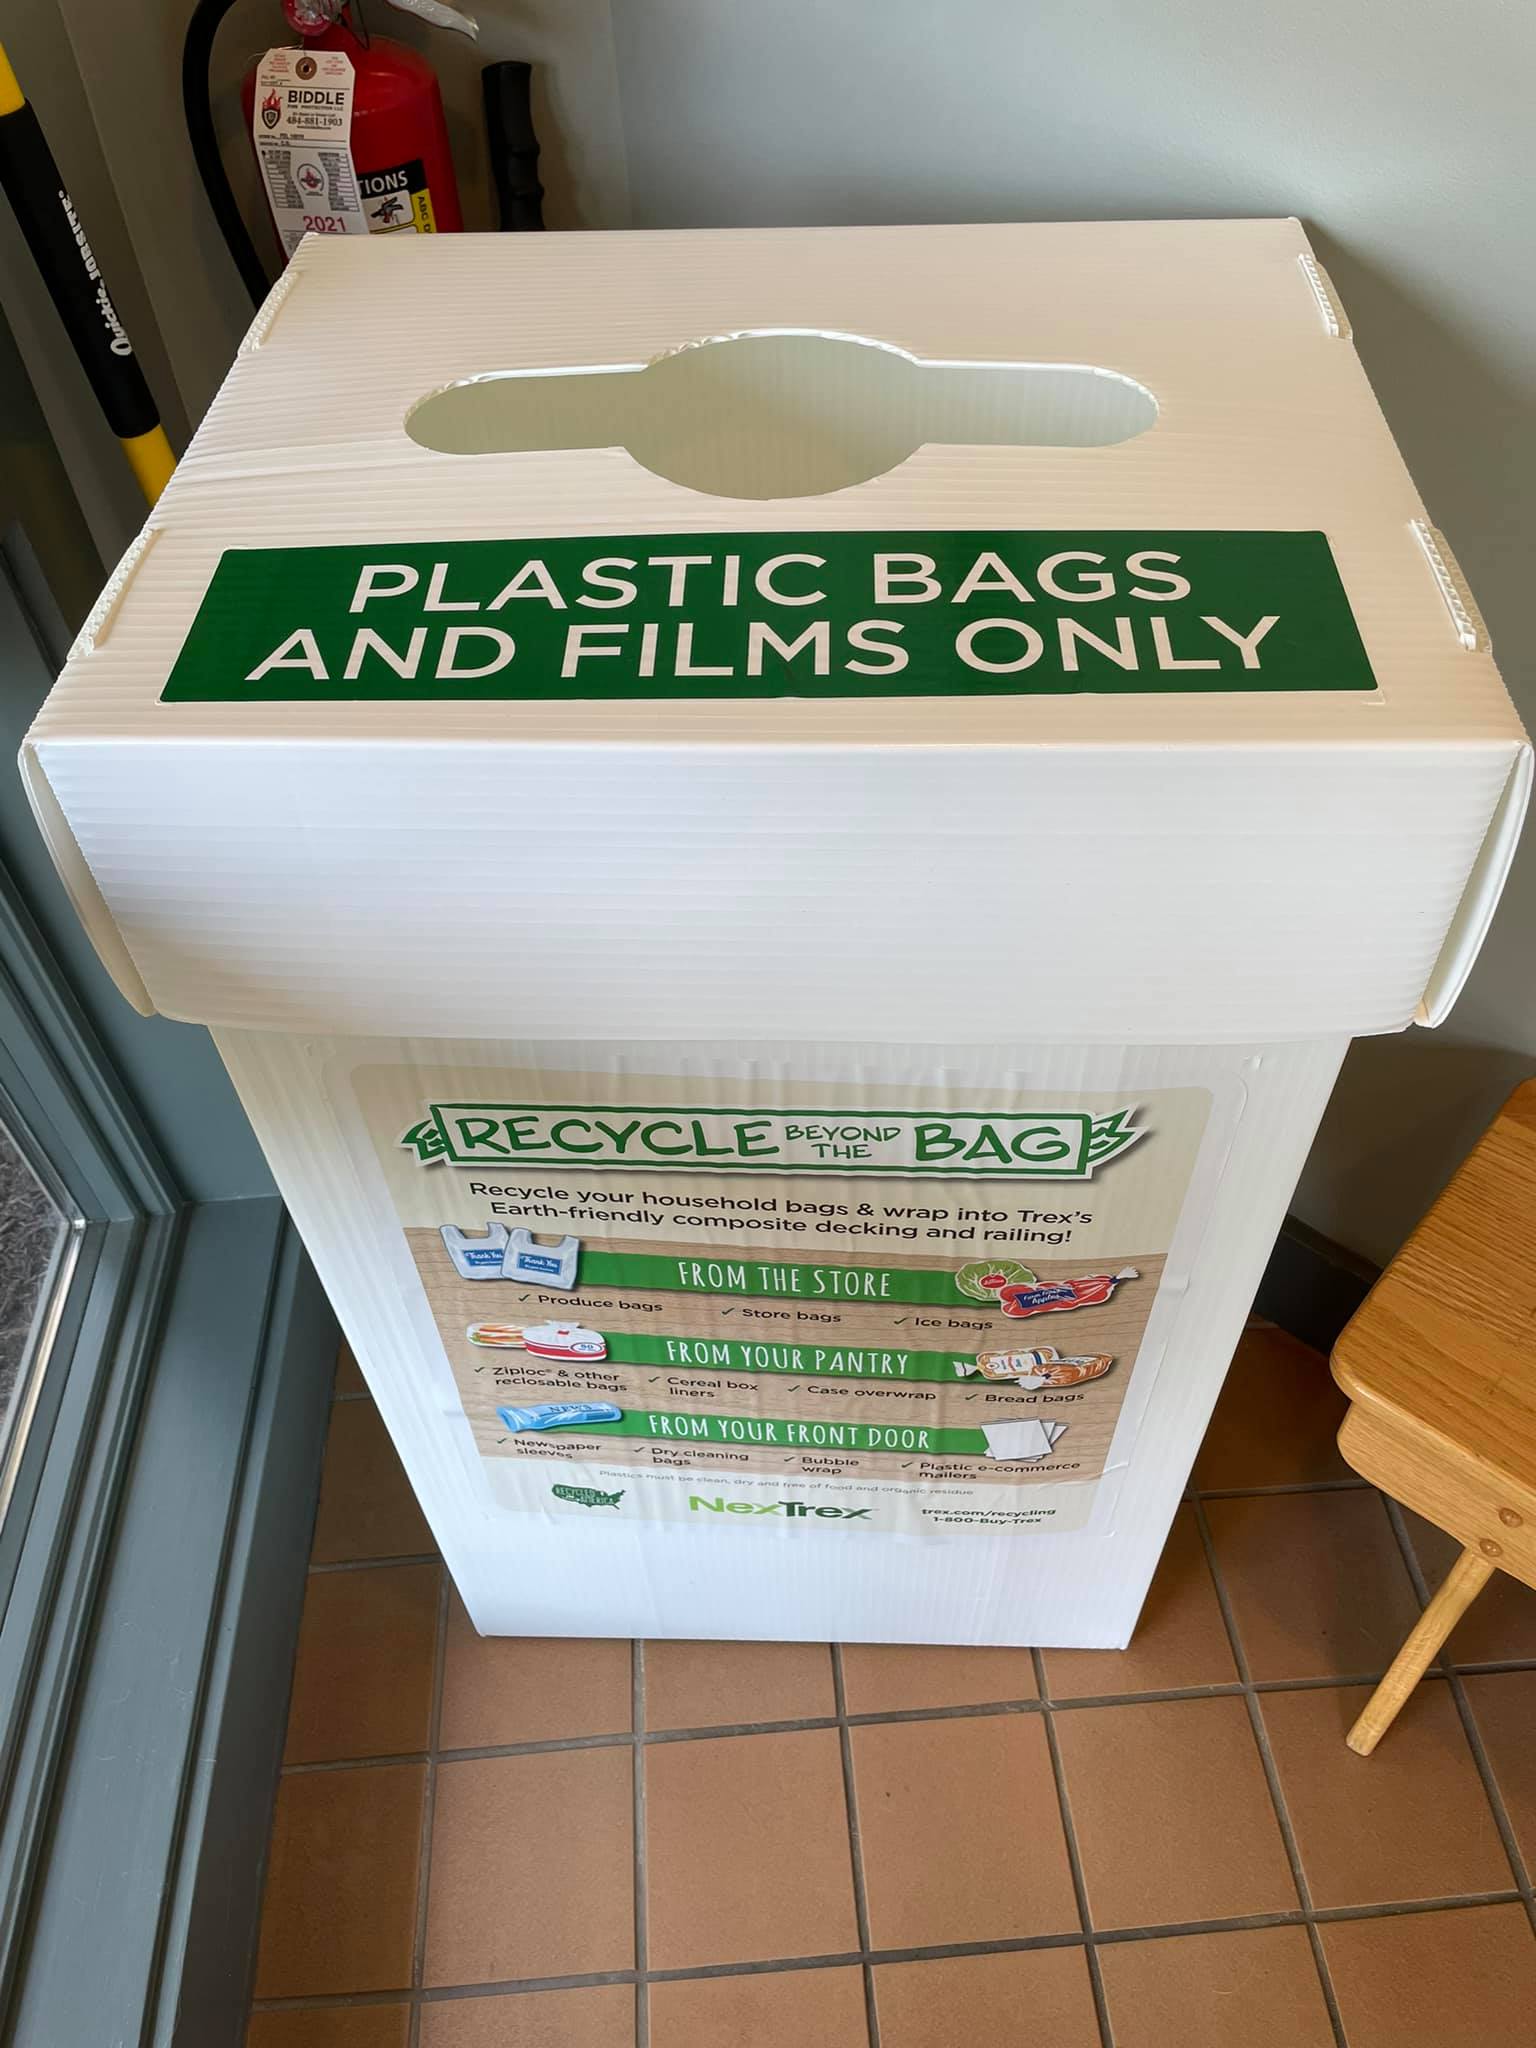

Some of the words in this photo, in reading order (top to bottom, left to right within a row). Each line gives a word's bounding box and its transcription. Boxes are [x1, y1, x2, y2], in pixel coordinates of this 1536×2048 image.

[288, 90, 345, 105] BIDDLE
[286, 116, 343, 127] 484-881-1903
[418, 196, 429, 220] ABC
[303, 216, 346, 232] 2021
[96, 279, 133, 356] Quickie
[349, 551, 828, 613] PLASTIC
[873, 550, 1192, 604] BAGS
[244, 627, 516, 681] AND
[560, 619, 910, 678] FILMS
[954, 615, 1281, 674] ONLY
[455, 1116, 780, 1157] RECYCLE
[785, 1124, 901, 1142] BEYOND
[811, 1143, 872, 1159] THE
[914, 1123, 1071, 1164] BAG
[470, 1182, 570, 1201] Recycle
[577, 1191, 634, 1205] your
[642, 1192, 777, 1212] household
[785, 1200, 849, 1217] bags
[857, 1203, 875, 1217] &
[884, 1208, 949, 1222] wrap
[957, 1207, 1008, 1223] into
[1017, 1209, 1092, 1224] Trex's
[491, 1201, 665, 1226] Earth-friendly
[672, 1211, 807, 1232] composite
[815, 1220, 918, 1240] decking
[926, 1225, 976, 1241] and
[983, 1228, 1072, 1245] railing!
[678, 1261, 747, 1290] FROM
[757, 1265, 801, 1292] THE
[813, 1269, 891, 1297] STORE
[538, 1294, 614, 1310] Produce
[619, 1297, 663, 1312] bags
[742, 1308, 791, 1320] Store
[797, 1310, 841, 1324] bags
[915, 1317, 942, 1329] Ice
[949, 1318, 993, 1331] bags
[666, 1340, 730, 1365] FROM
[740, 1345, 804, 1371] YOUR
[816, 1349, 908, 1376] PANTRY
[558, 1369, 569, 1378] &
[574, 1371, 620, 1382] other
[495, 1377, 581, 1389] reclosable
[587, 1382, 627, 1393] bags
[667, 1376, 721, 1389] Cereal
[727, 1380, 759, 1391] box
[670, 1387, 715, 1399] liners
[808, 1386, 849, 1397] Case
[854, 1389, 937, 1401] overwrap
[985, 1393, 1037, 1404] Bread
[1043, 1392, 1085, 1405] bags
[548, 1404, 593, 1413] NEWS
[649, 1415, 709, 1438] FROM
[717, 1419, 777, 1441] YOUR
[787, 1423, 857, 1447] FRONT
[868, 1428, 930, 1449] DOOR
[513, 1438, 602, 1452] Newspaper
[516, 1447, 573, 1459] sleeves
[651, 1448, 678, 1459] Dry
[682, 1450, 749, 1463] cleaning
[652, 1456, 691, 1467] bags
[801, 1456, 859, 1467] Bubble
[919, 1461, 973, 1472] Plastic
[977, 1461, 1080, 1473] e-commerce
[801, 1466, 842, 1475] wrap
[919, 1470, 977, 1480] mailers
[599, 1470, 643, 1479] Plastics
[696, 1477, 731, 1485] clean,
[734, 1479, 753, 1487] dry
[881, 1487, 927, 1495] organic
[688, 1495, 873, 1520] NexTrex
[921, 1506, 1057, 1518] trex.com/recycling
[932, 1516, 1042, 1526] 1-800-Buy-Trex
